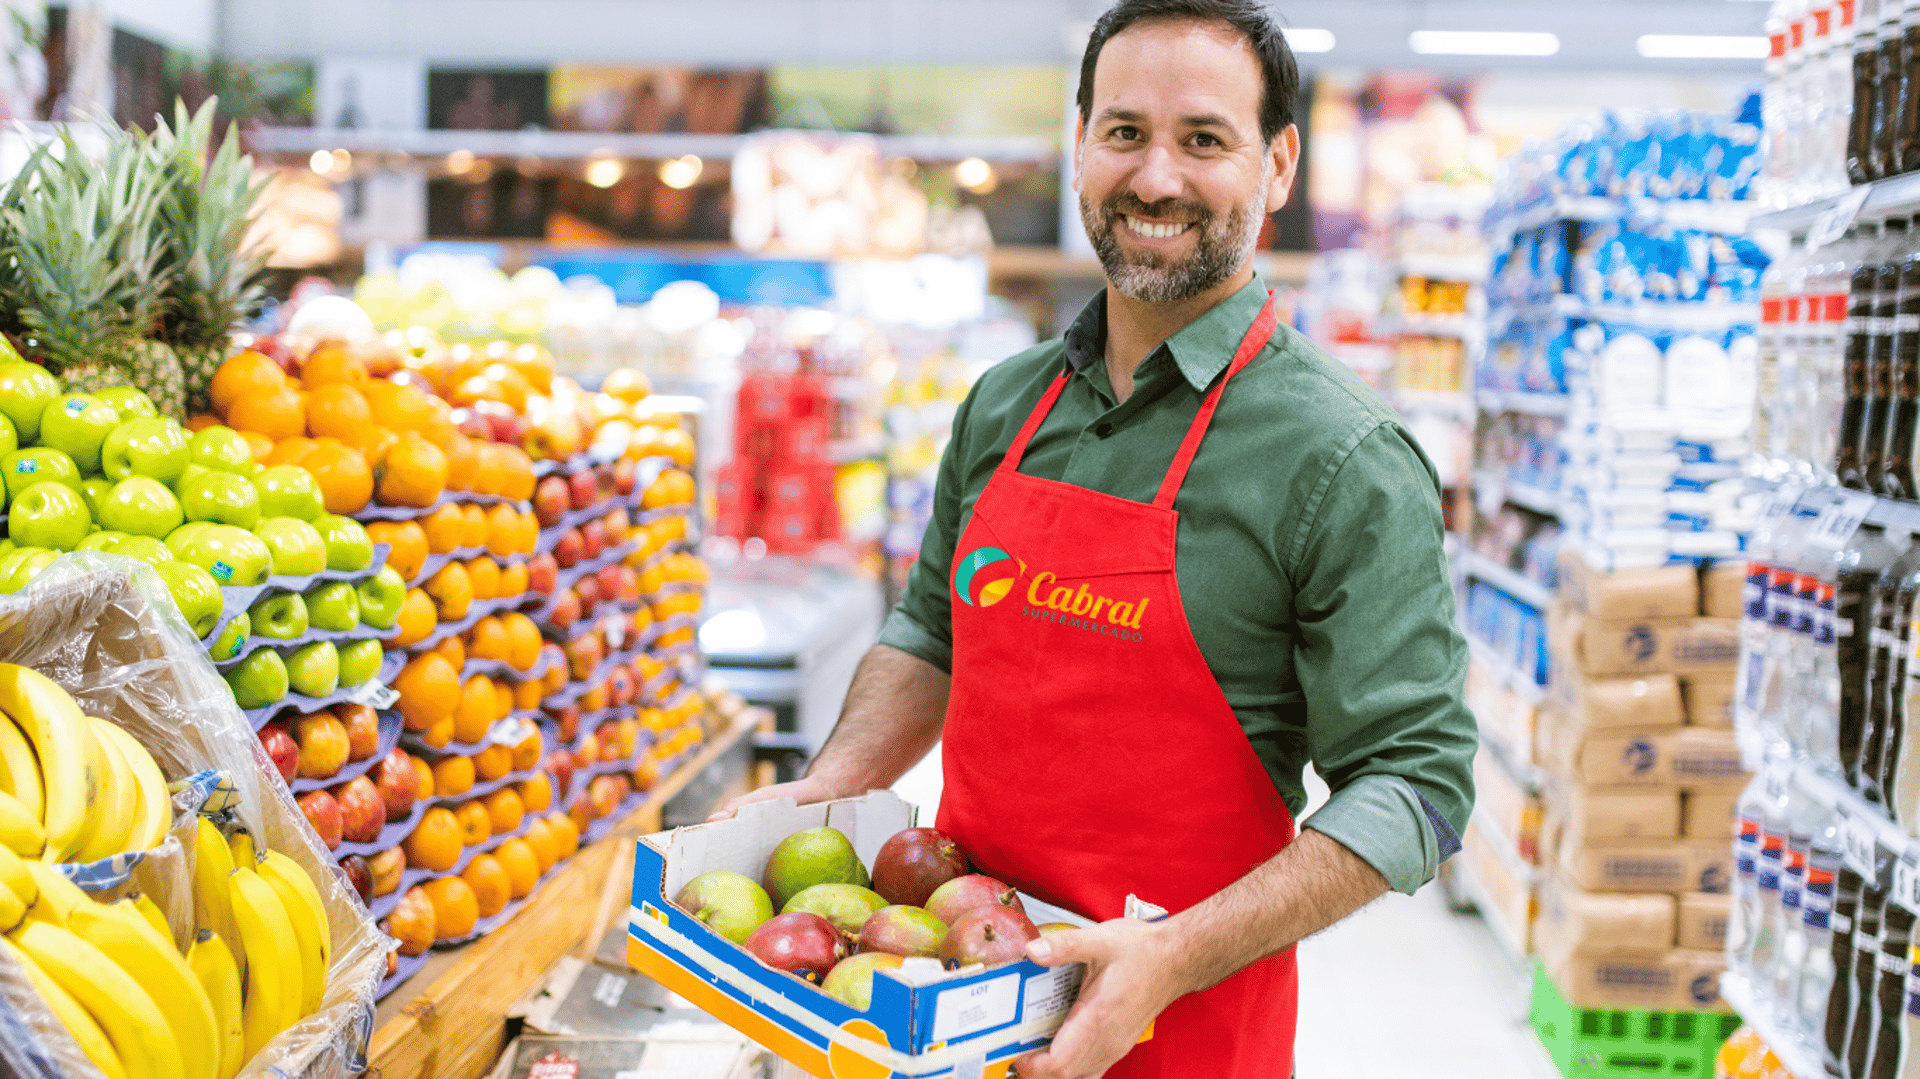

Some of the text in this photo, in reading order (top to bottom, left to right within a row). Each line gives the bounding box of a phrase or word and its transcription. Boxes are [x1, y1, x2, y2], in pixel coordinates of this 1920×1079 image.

[1027, 571, 1149, 629] Cabral
[1022, 605, 1142, 643] SUPERMERCADO
[970, 984, 989, 997] LOT
